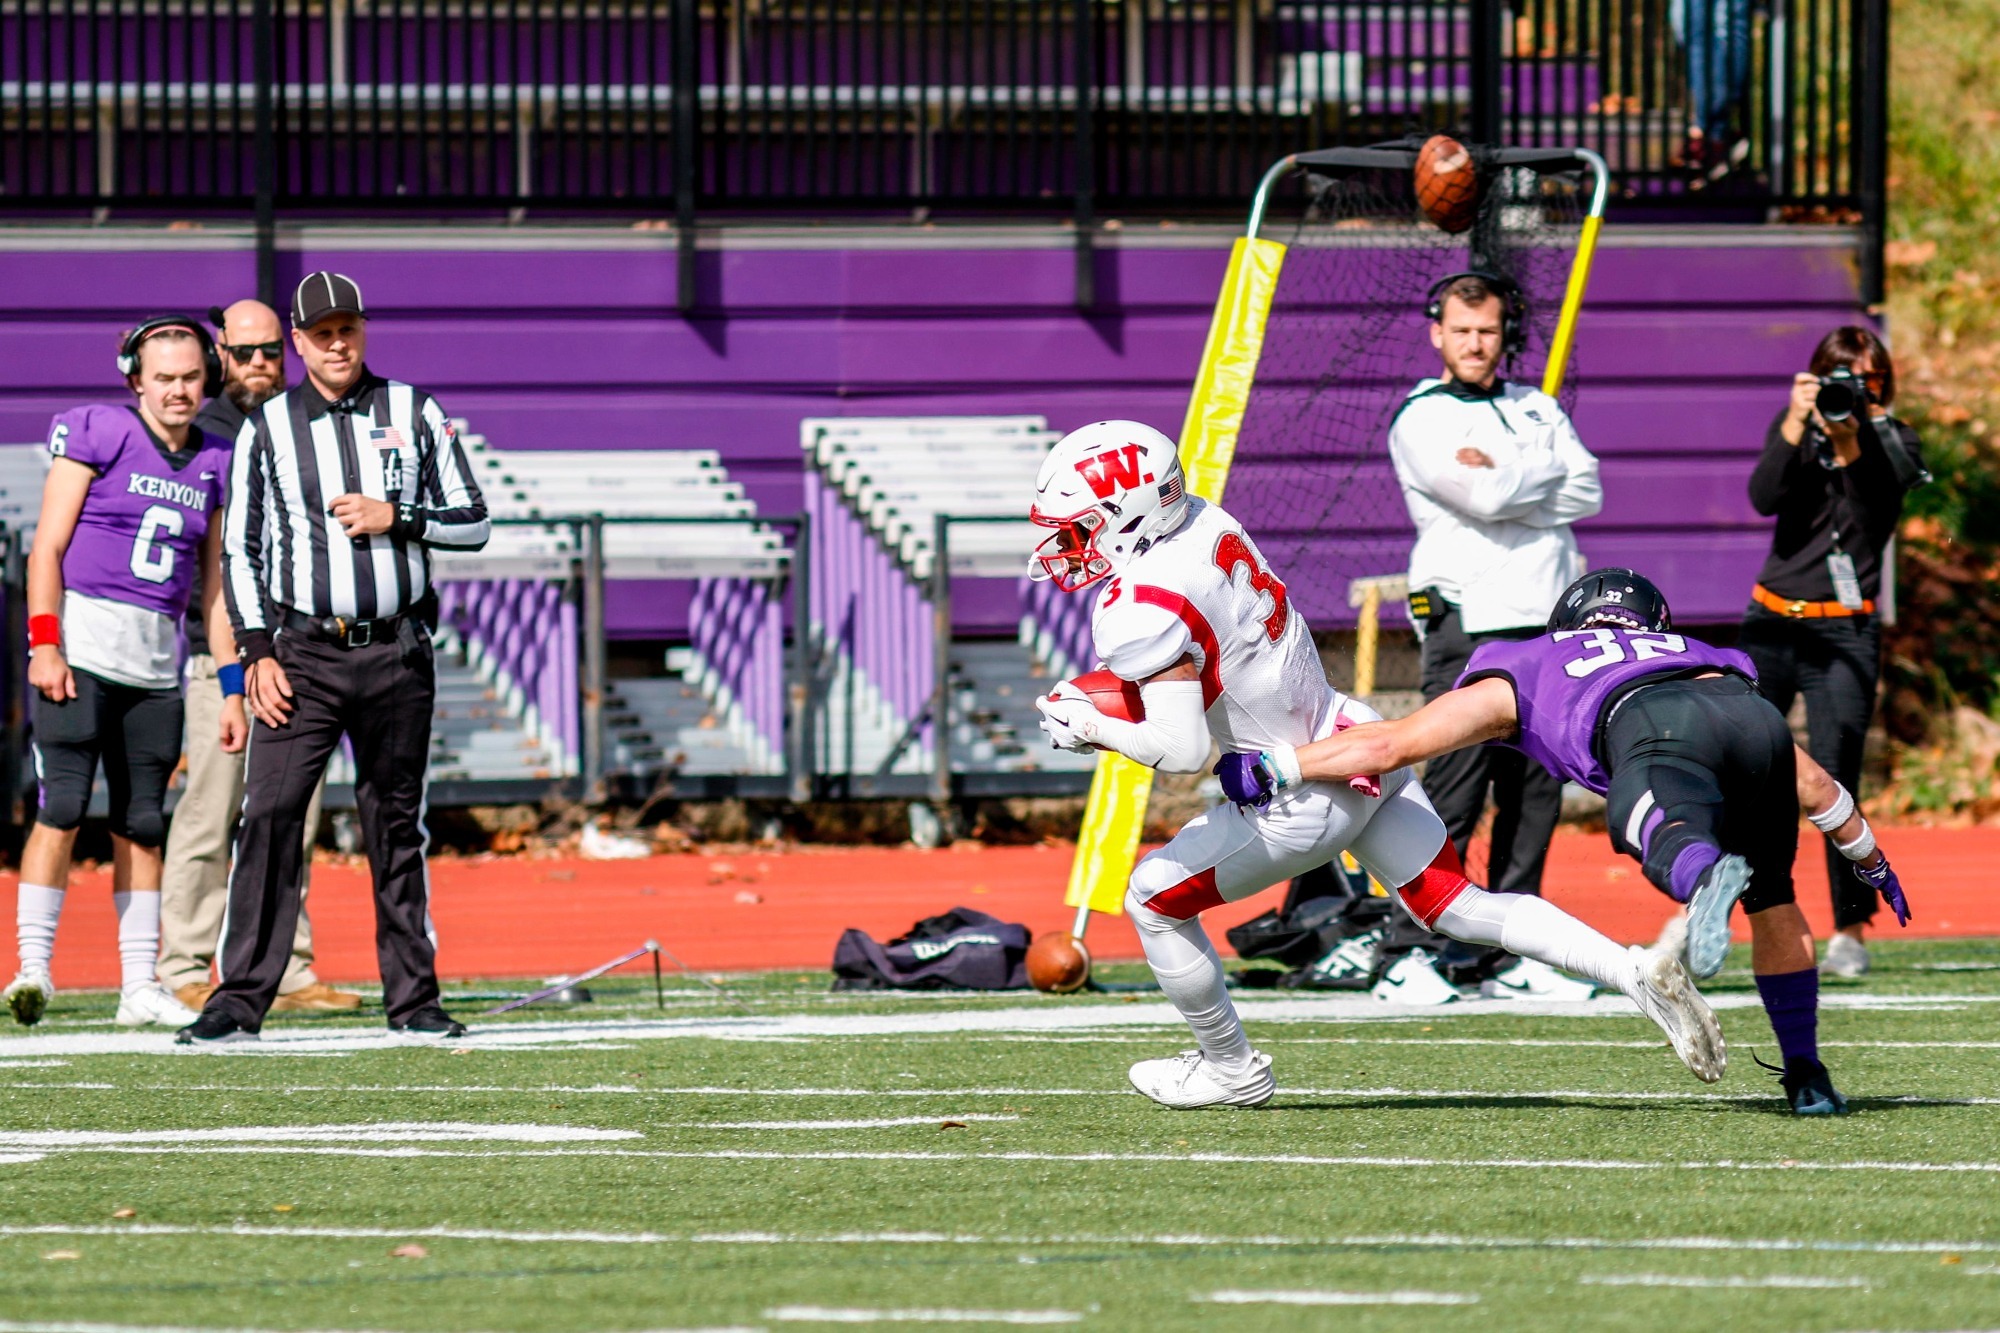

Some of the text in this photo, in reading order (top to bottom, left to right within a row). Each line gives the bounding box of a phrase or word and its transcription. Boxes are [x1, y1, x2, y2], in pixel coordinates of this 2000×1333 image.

[127, 472, 207, 512] KENYON
[129, 503, 185, 585] 6
[1212, 530, 1290, 644] 3
[1604, 589, 1623, 604] 32
[1551, 628, 1687, 678] 32
